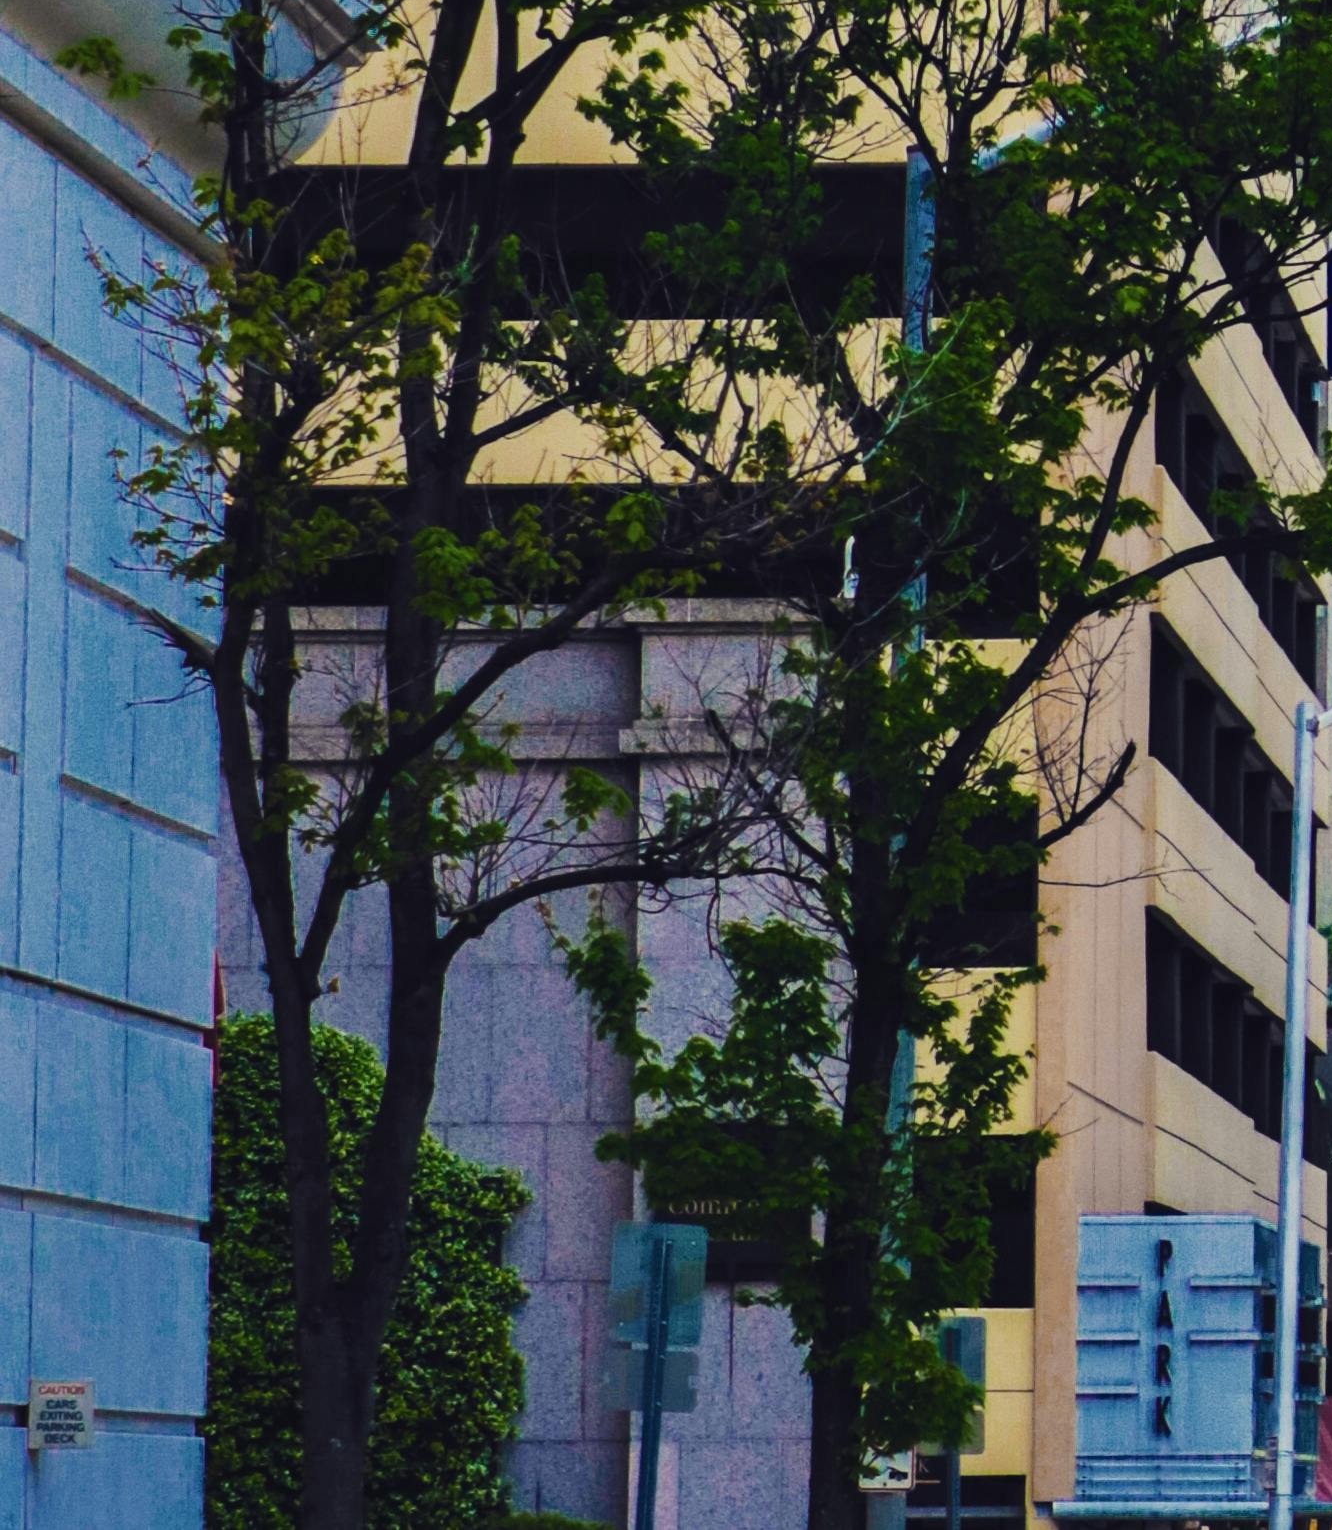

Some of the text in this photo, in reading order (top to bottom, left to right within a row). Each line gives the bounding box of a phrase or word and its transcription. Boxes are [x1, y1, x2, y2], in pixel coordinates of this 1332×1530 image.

[1156, 1238, 1174, 1439] PARK
[39, 1385, 85, 1395] CAUTION
[46, 1399, 77, 1410] CARS
[40, 1411, 83, 1421] EXITING
[36, 1422, 85, 1432] PARKING
[44, 1433, 77, 1445] DECK
